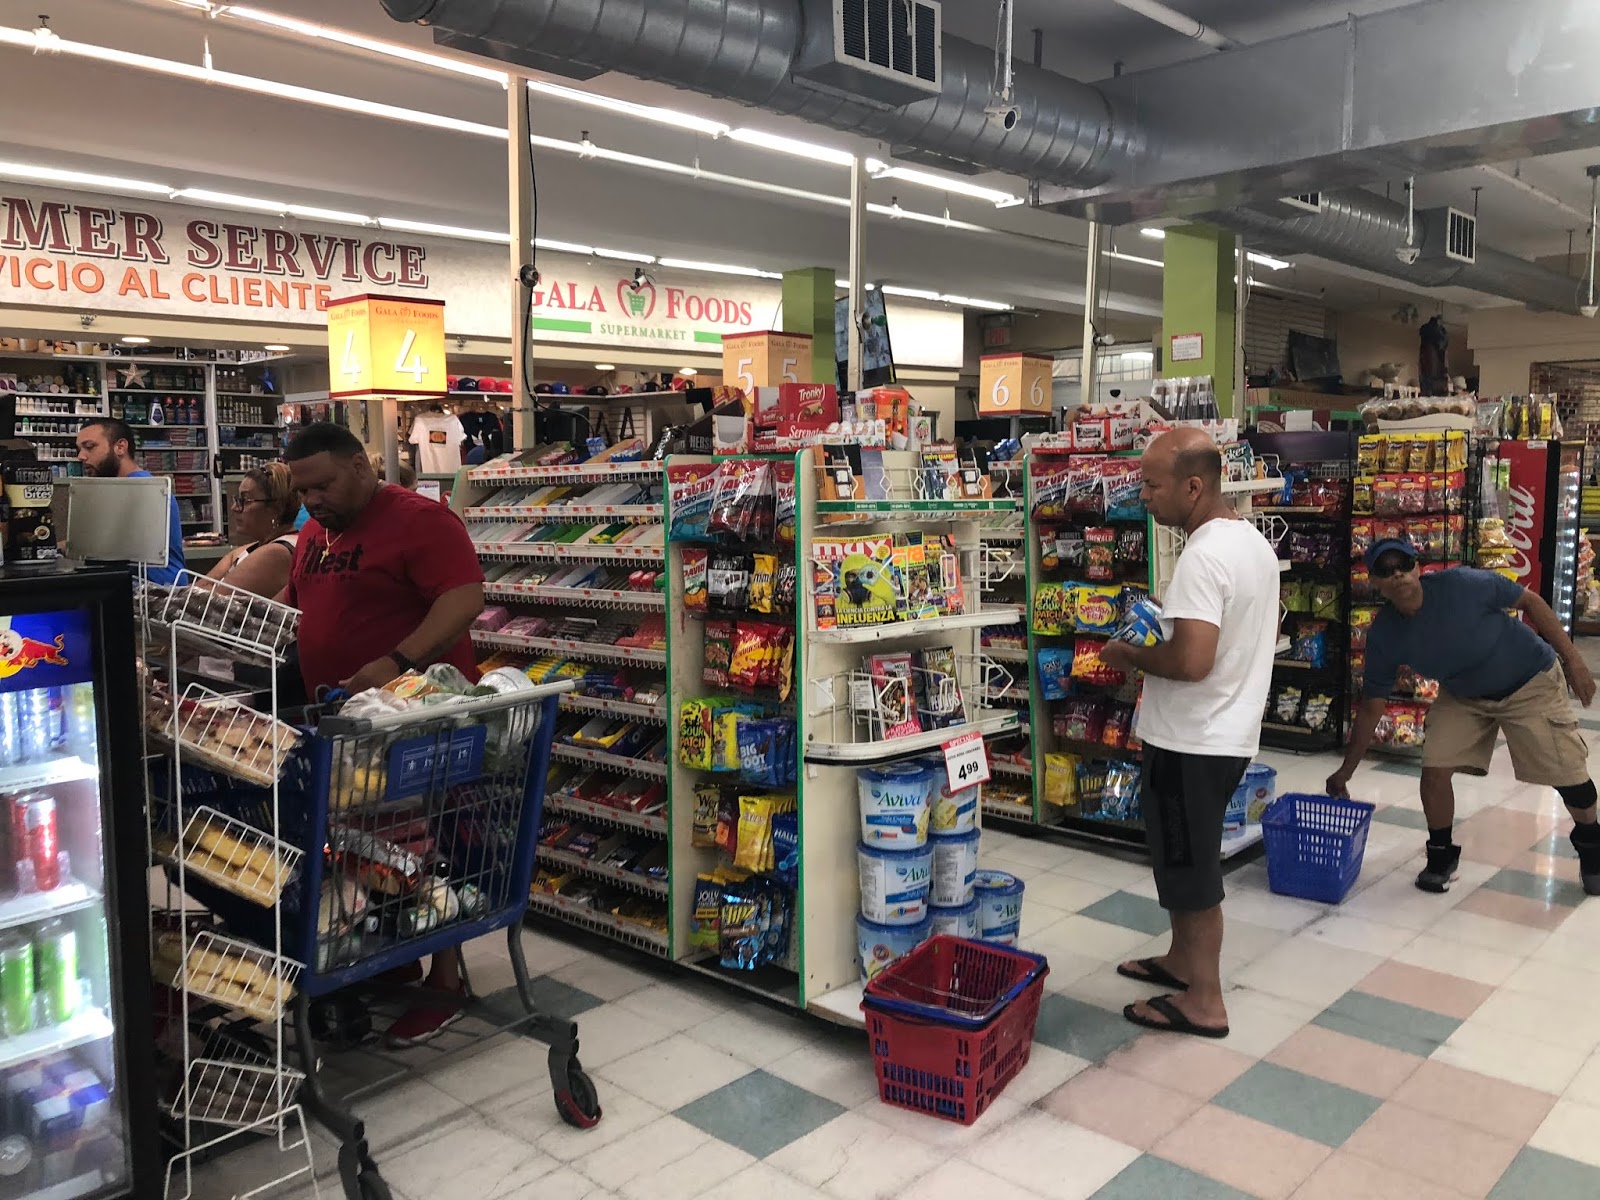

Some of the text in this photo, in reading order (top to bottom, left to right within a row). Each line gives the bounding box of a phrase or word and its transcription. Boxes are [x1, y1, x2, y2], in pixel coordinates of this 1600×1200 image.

[187, 219, 429, 289] SERVICE
[118, 266, 170, 300] AL
[181, 273, 332, 312] CLIENTE
[375, 306, 439, 319] GALA FOODS
[665, 288, 752, 325] FOODS
[600, 323, 687, 341] SUPERMARKET
[342, 329, 361, 384] 4
[395, 328, 429, 384] 4
[737, 357, 755, 396] 5
[782, 357, 798, 384] 5
[799, 384, 823, 401] Tronky
[992, 374, 1010, 406] 6
[1030, 375, 1044, 406] 6
[24, 487, 53, 500] bites
[673, 478, 715, 501] DAVID
[812, 539, 887, 558] muy
[683, 563, 705, 577] DAVID
[837, 610, 895, 624] INFLUENZA
[1080, 604, 1110, 616] Swedish
[680, 724, 705, 737] SOUR
[680, 736, 706, 748] PATCH
[741, 743, 757, 758] BIG
[878, 791, 922, 807] Aviva
[773, 828, 798, 843] HALLS
[698, 890, 720, 901] JOLLY
